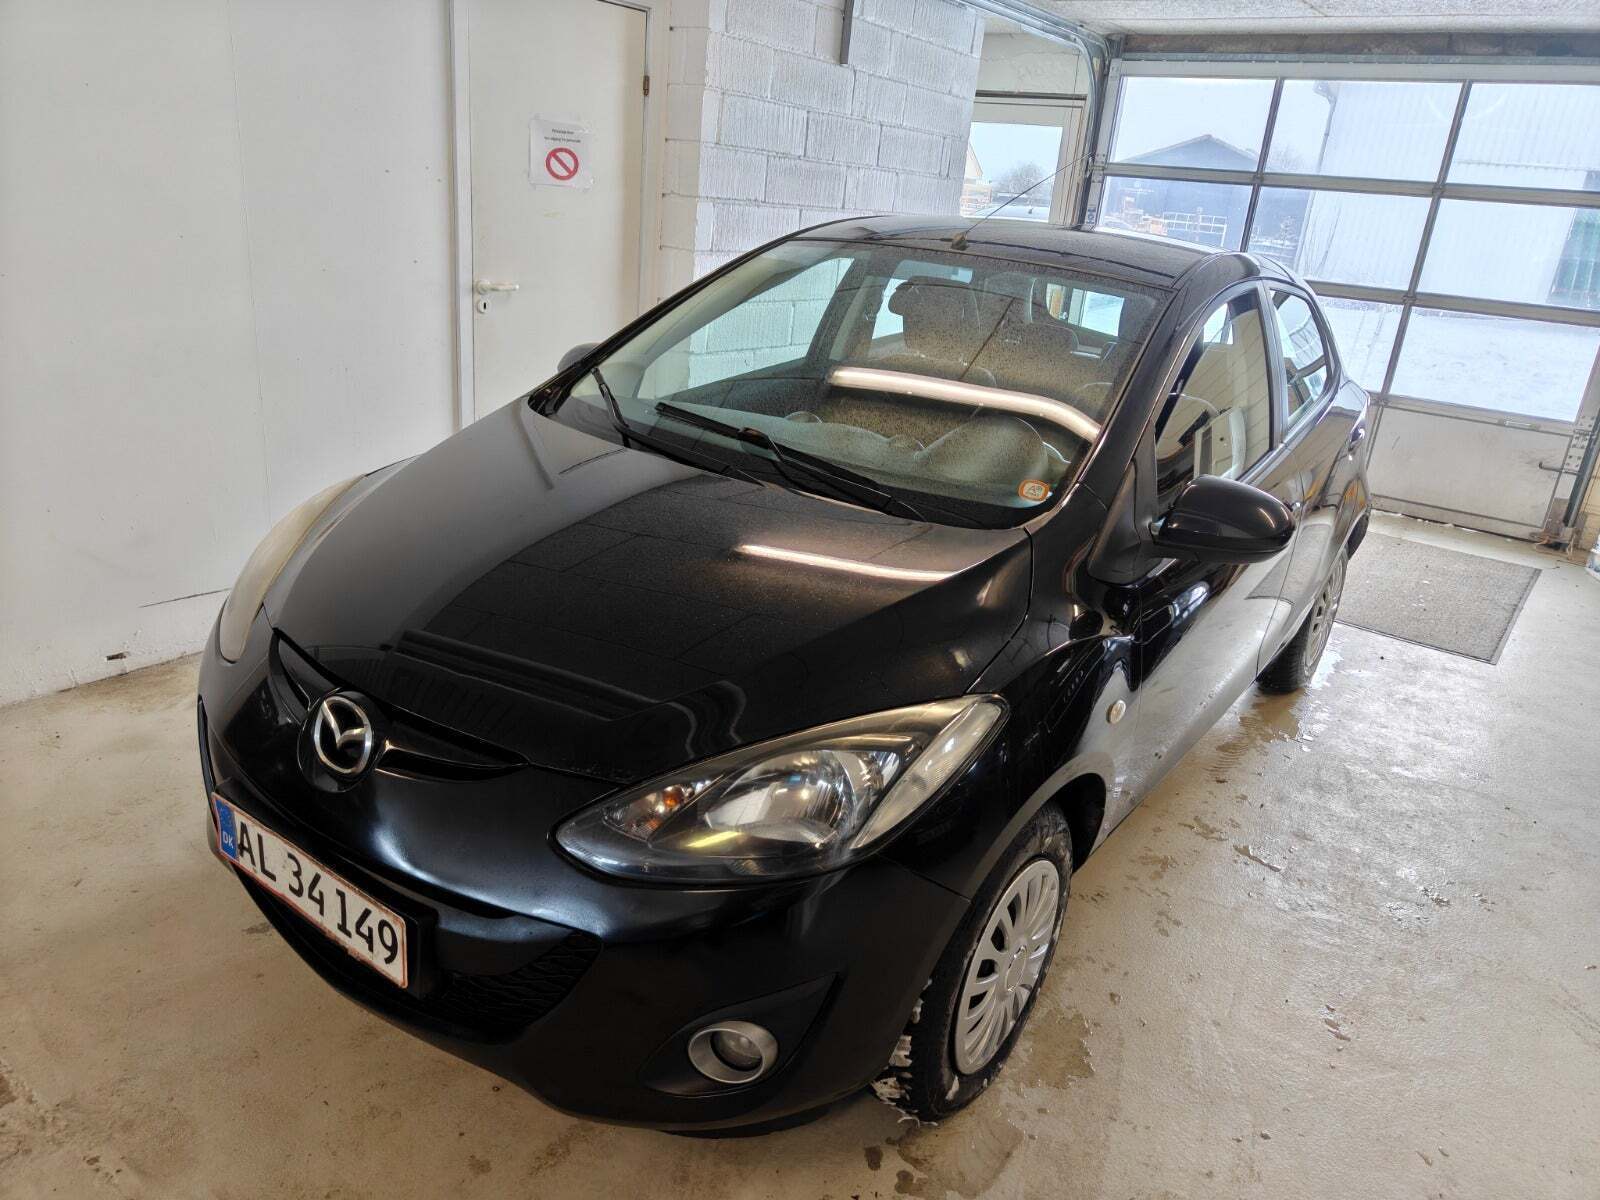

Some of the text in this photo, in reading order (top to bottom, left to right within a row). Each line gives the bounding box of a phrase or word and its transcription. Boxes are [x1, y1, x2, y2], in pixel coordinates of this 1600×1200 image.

[222, 831, 234, 849] DK
[238, 821, 399, 965] AL 34 149
